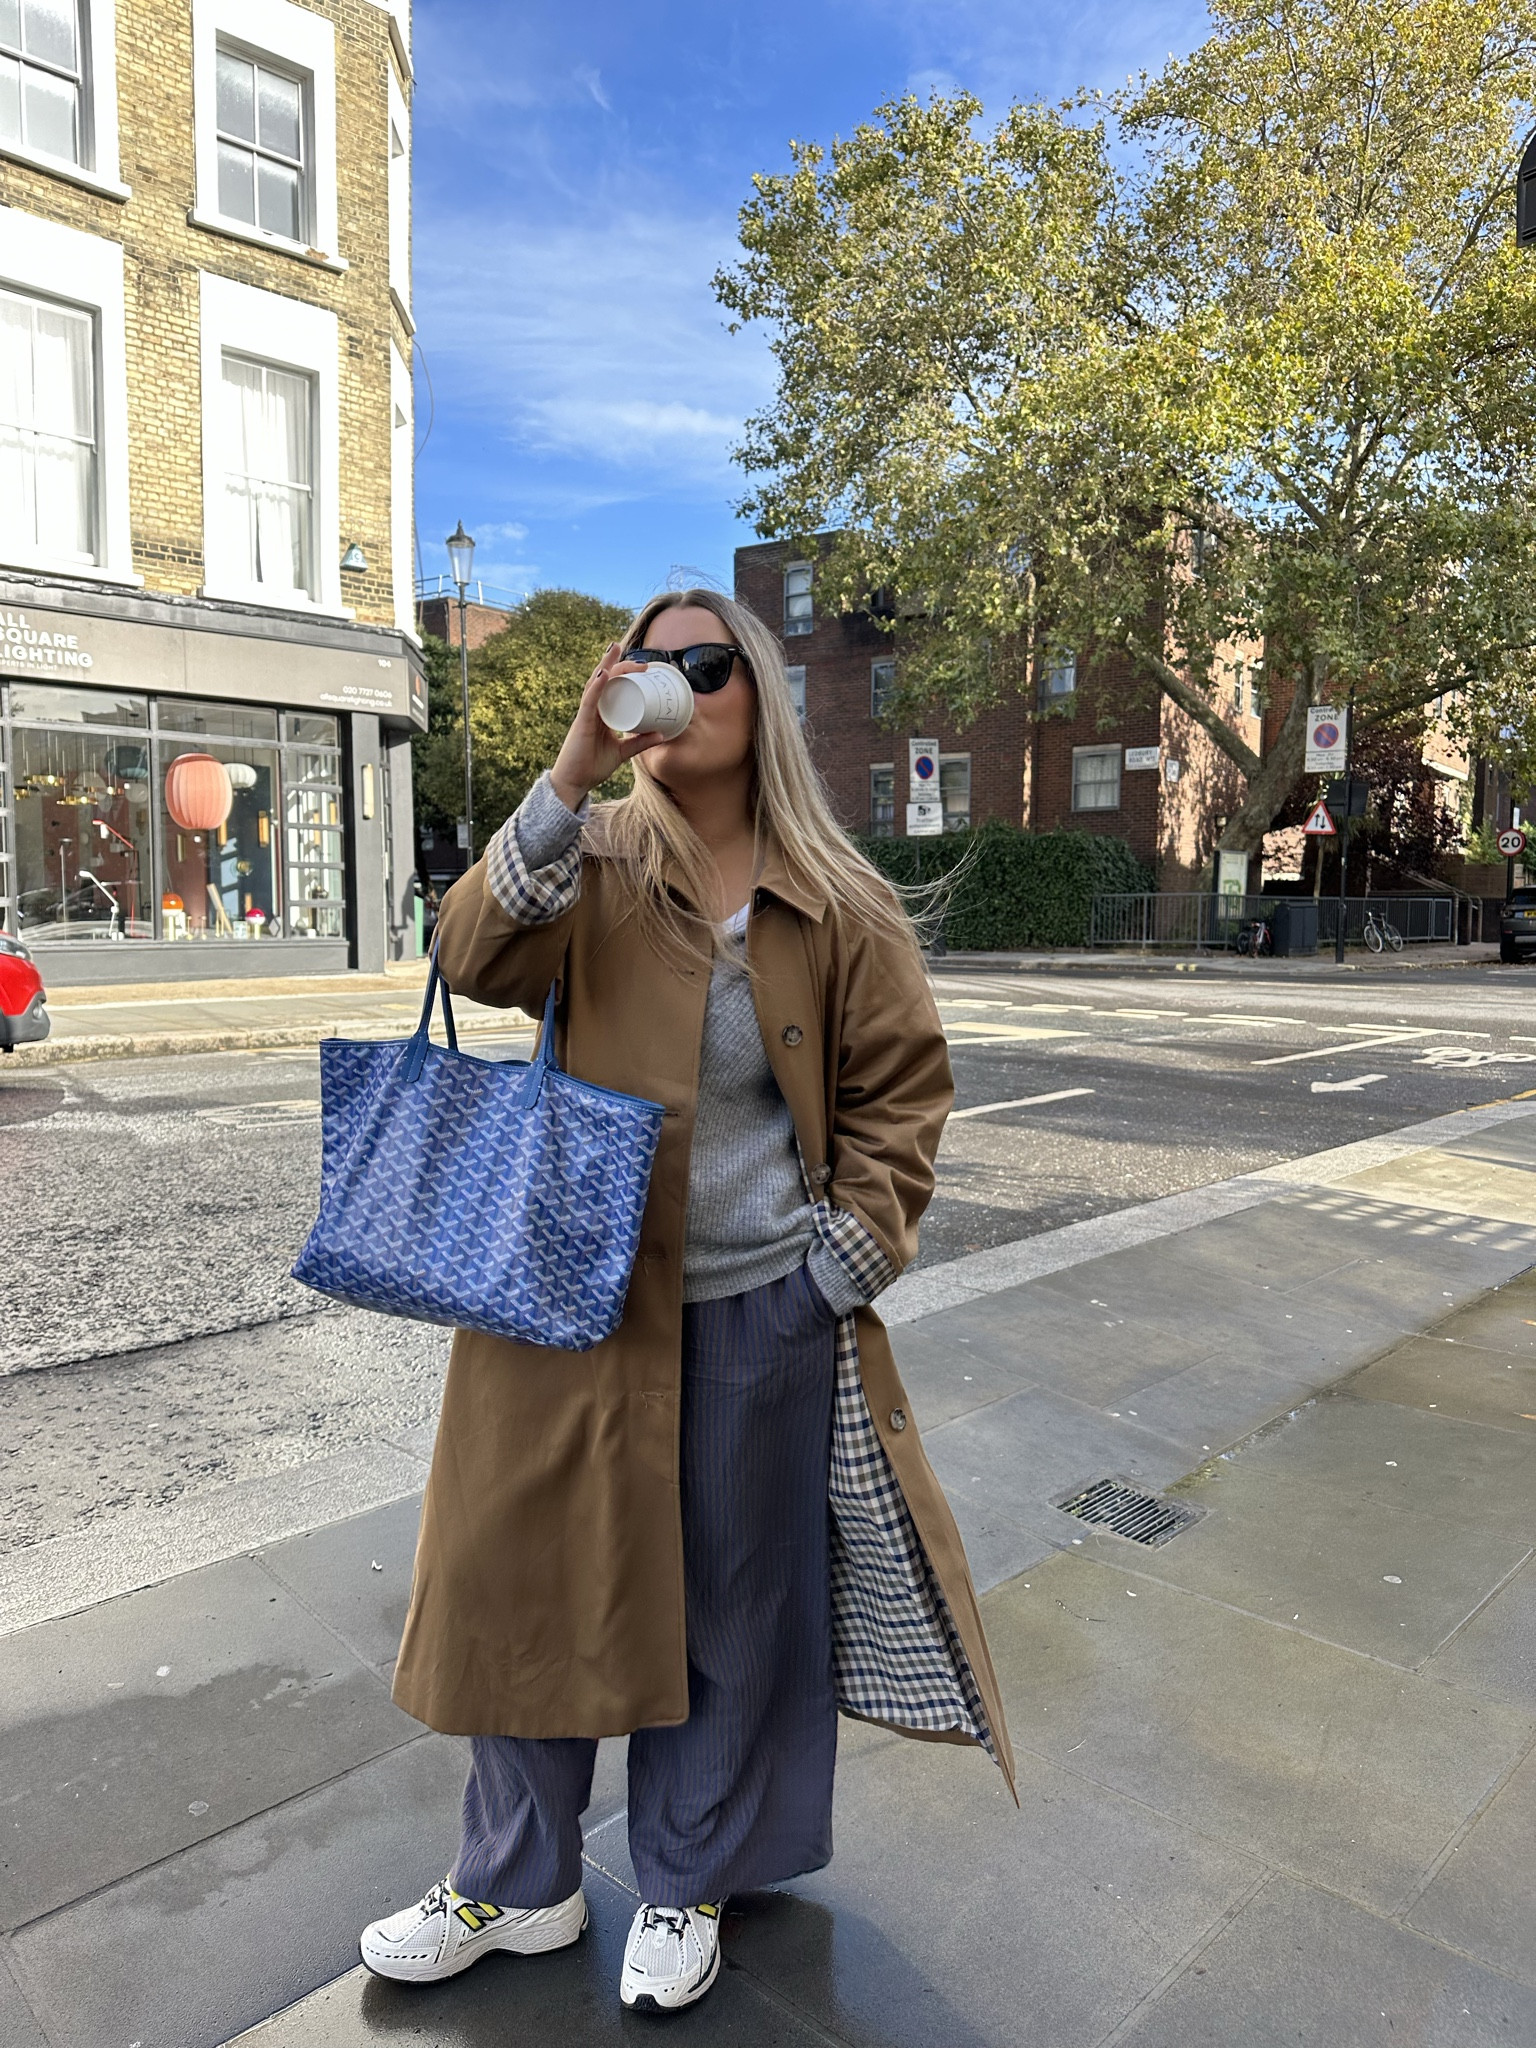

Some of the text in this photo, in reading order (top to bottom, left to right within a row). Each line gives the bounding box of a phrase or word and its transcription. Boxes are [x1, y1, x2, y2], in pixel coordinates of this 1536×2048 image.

[0, 643, 93, 668] IGHTING
[343, 686, 357, 694] 020
[359, 687, 373, 696] 7727
[1315, 714, 1338, 722] ZONE
[1501, 836, 1521, 849] 20
